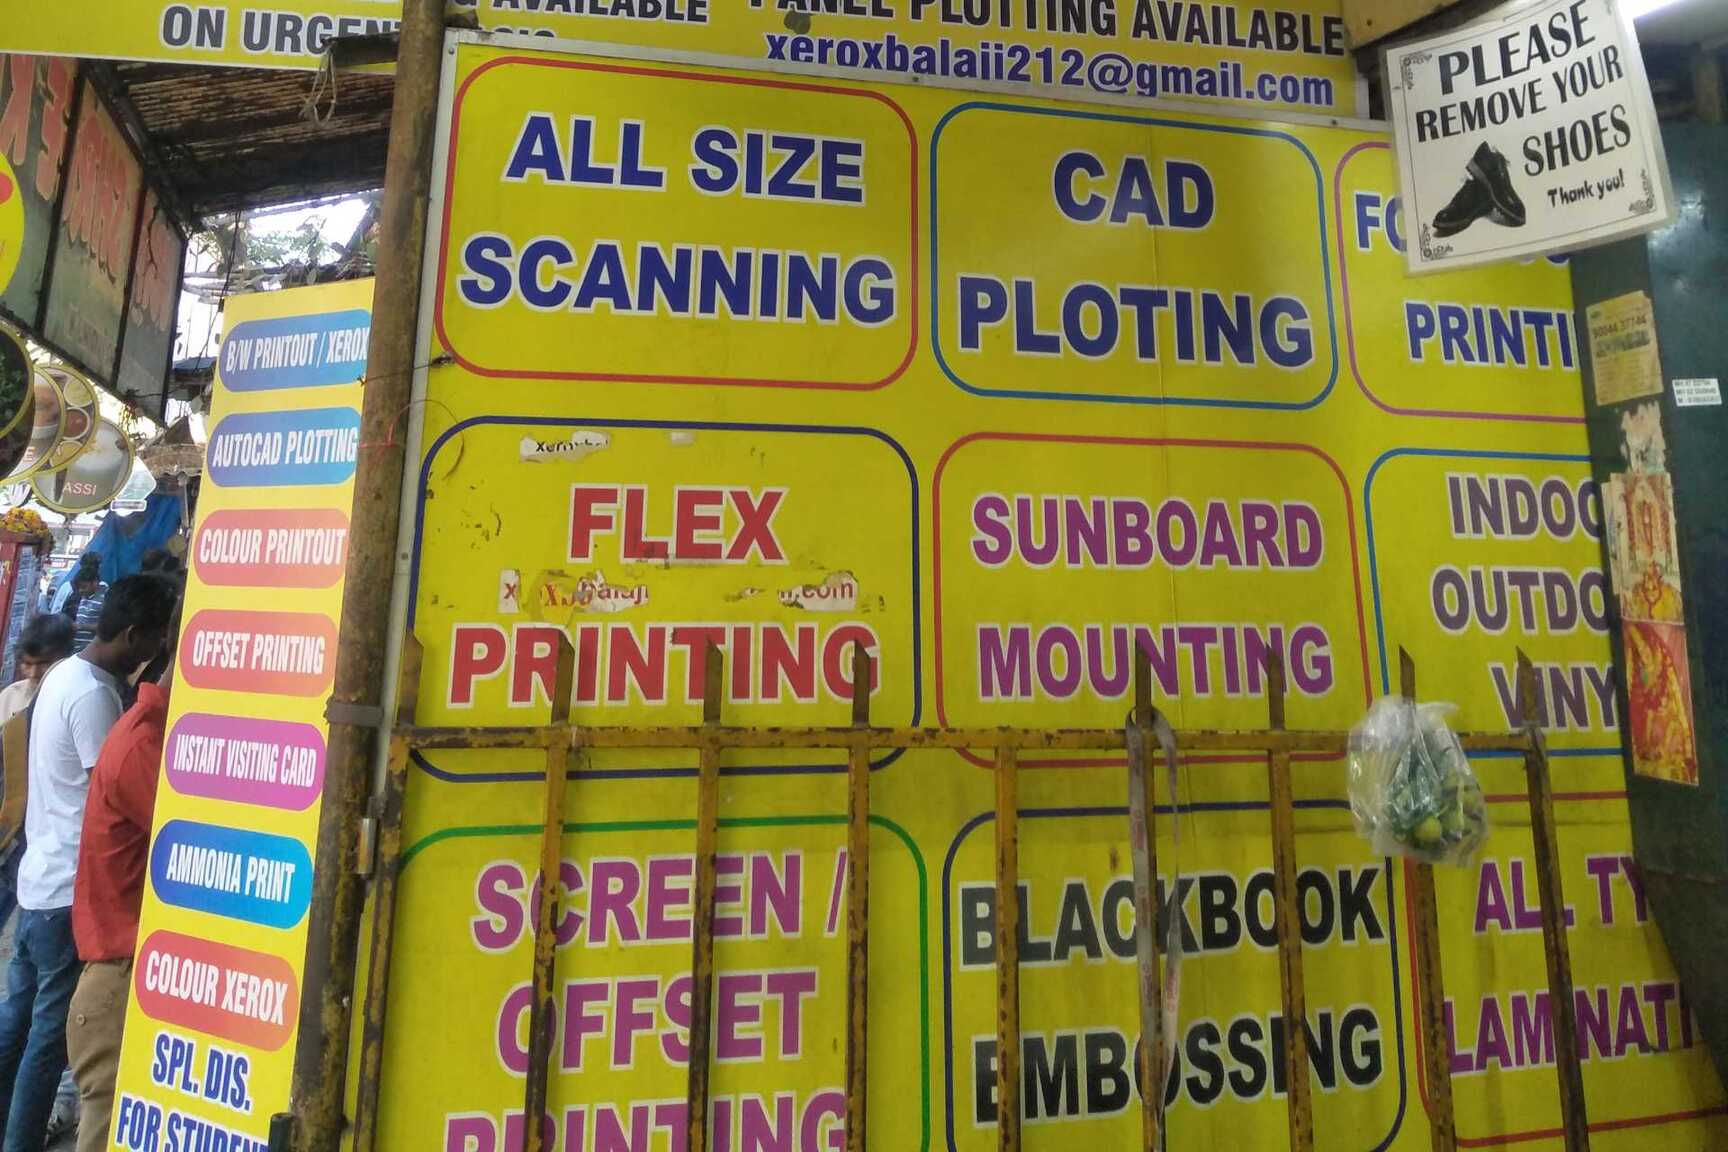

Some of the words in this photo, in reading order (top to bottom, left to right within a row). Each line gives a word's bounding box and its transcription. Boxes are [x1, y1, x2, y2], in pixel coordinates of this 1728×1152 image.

[162, 5, 227, 48] ON
[1416, 78, 1546, 143] REMOVE
[1552, 44, 1624, 104] YOUR
[505, 115, 665, 188] ALL
[690, 129, 864, 203] SIZE
[1522, 104, 1632, 177] SHOES
[1054, 151, 1215, 229] CAD
[1547, 179, 1595, 209] Thank
[1598, 169, 1625, 200] you!
[460, 236, 896, 325] SCANNING
[226, 338, 252, 375] B/W
[253, 332, 318, 370] PRINTOUT
[326, 327, 370, 364] XEROX
[959, 276, 1313, 368] PLOTING
[1405, 302, 1581, 368] PRINTI
[212, 431, 284, 468] AUTOCAD
[285, 426, 358, 465] PLOTTING
[200, 528, 263, 564] COLOUR
[264, 528, 346, 565] PRINTOUT
[568, 487, 786, 561] FLEX
[971, 496, 1323, 568] SUNBOARD
[1432, 568, 1609, 631] OUTDO
[192, 629, 250, 669] OFFSET
[251, 633, 326, 675] PRINTING
[449, 625, 879, 705] PRINTING
[979, 626, 1333, 697] MOUNTING
[1491, 663, 1617, 729] VINY
[173, 734, 226, 776] INSTANT
[225, 738, 279, 783] VISITING
[280, 744, 317, 788] CARD
[166, 843, 242, 894] AMMONIA
[244, 856, 296, 904] PRINT
[472, 854, 801, 949] SCREEN
[961, 867, 1385, 965] BLACKBOOK
[145, 950, 219, 1007] COLOUR
[221, 968, 288, 1026] XEROX
[498, 971, 817, 1074] OFFSET
[1443, 982, 1694, 1074] LAMNATI
[153, 1034, 198, 1094] SPL.
[204, 1048, 250, 1111] DIS.
[116, 1096, 161, 1152] FOR
